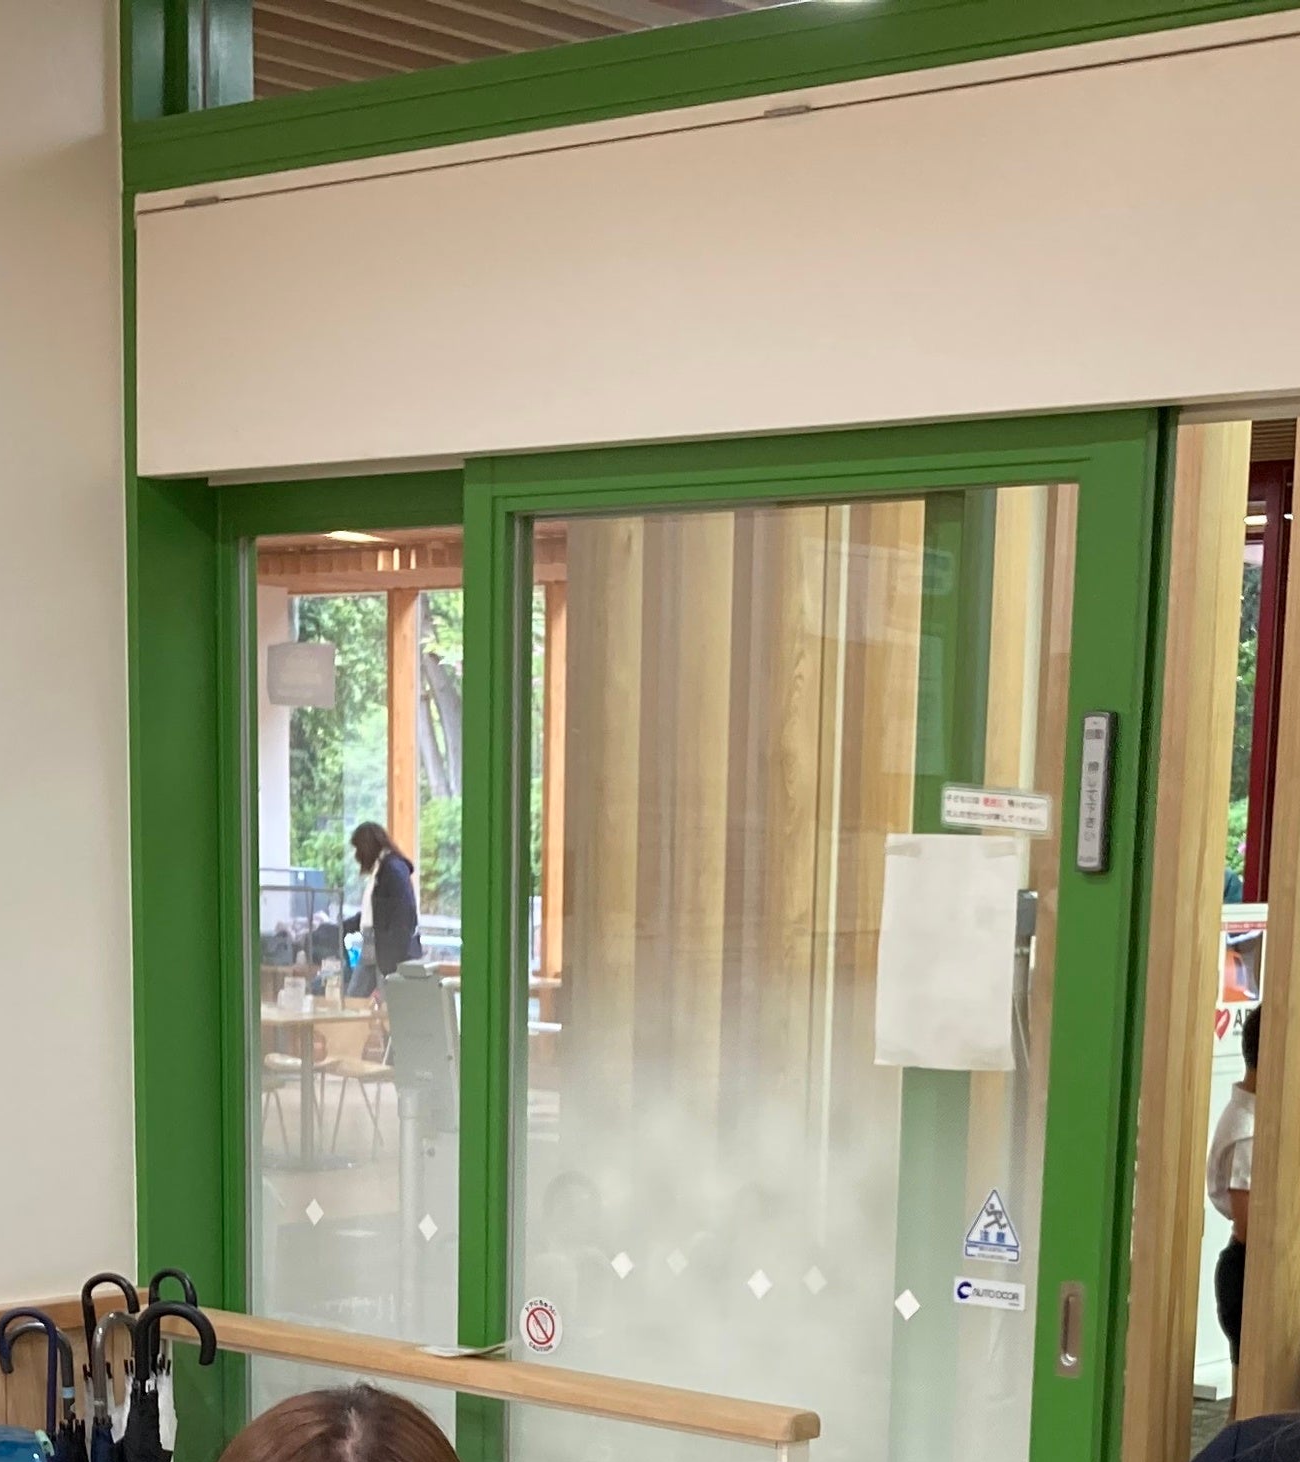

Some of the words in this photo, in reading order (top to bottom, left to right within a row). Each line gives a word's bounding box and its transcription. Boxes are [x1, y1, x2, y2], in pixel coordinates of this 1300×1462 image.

[972, 1288, 996, 1299] AUTO
[996, 1290, 1020, 1302] DOOR
[529, 1342, 553, 1351] CAUTION
